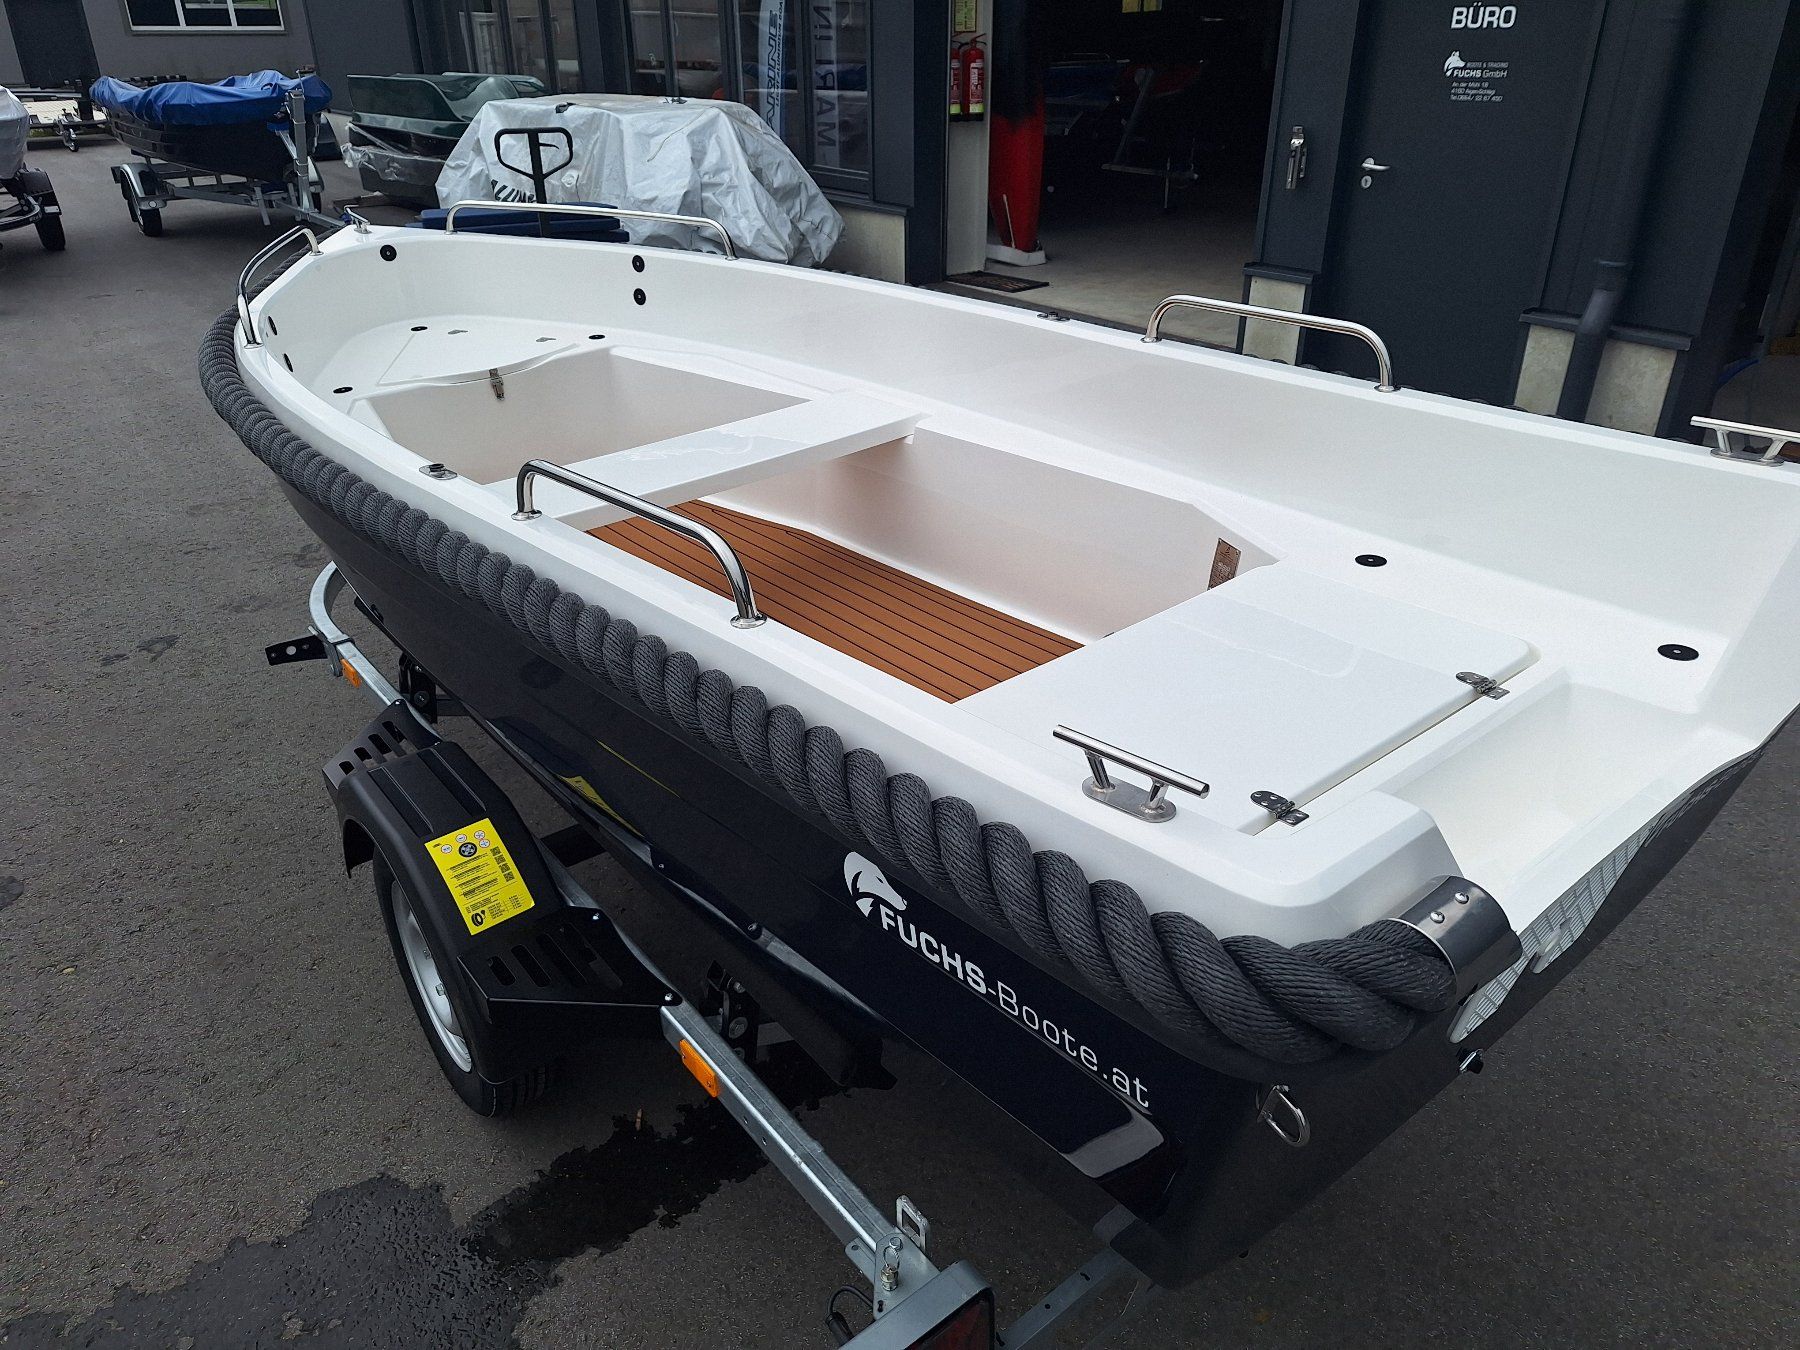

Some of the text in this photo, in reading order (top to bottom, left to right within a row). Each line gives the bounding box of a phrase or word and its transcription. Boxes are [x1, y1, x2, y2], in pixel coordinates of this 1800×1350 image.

[1451, 2, 1517, 29] BÜRO
[766, 9, 778, 128] ARINE
[1453, 69, 1508, 78] FUCHS GmbH
[879, 904, 1149, 1108] FUCHS-Boote.at
